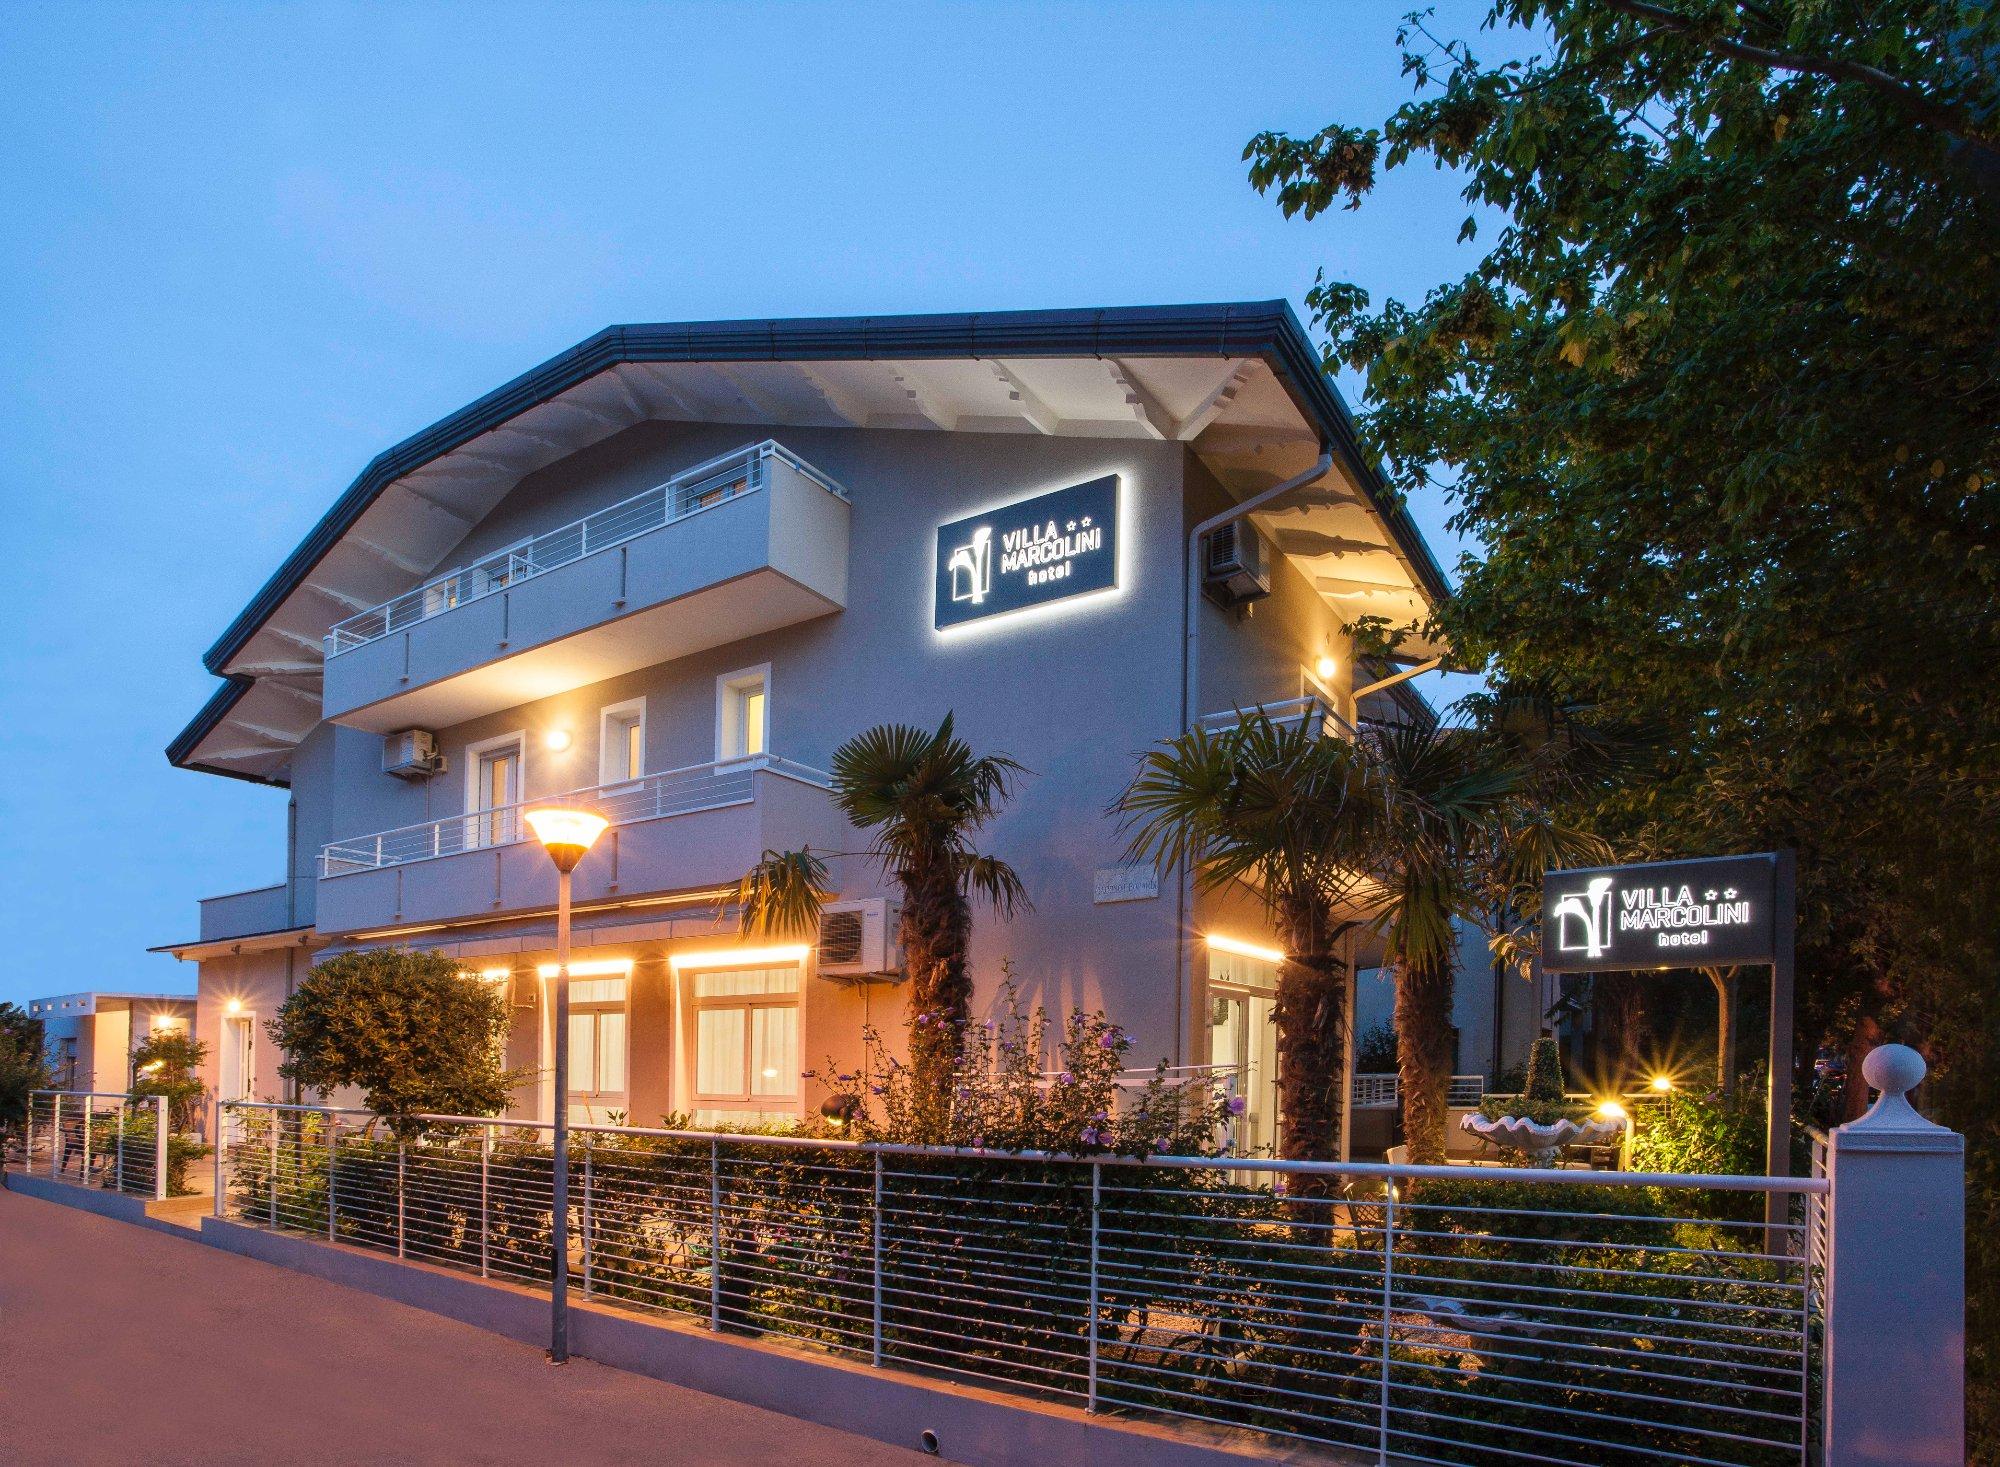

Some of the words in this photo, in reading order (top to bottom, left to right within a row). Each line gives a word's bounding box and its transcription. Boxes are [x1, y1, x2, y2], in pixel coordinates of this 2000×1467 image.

[1003, 521, 1057, 552] VILLA
[1001, 528, 1100, 573] MARCOLINI
[1028, 561, 1070, 585] hotel
[1622, 885, 1694, 909] VILLA
[1620, 902, 1749, 930] MARCOLINI
[1658, 930, 1708, 946] hotel
